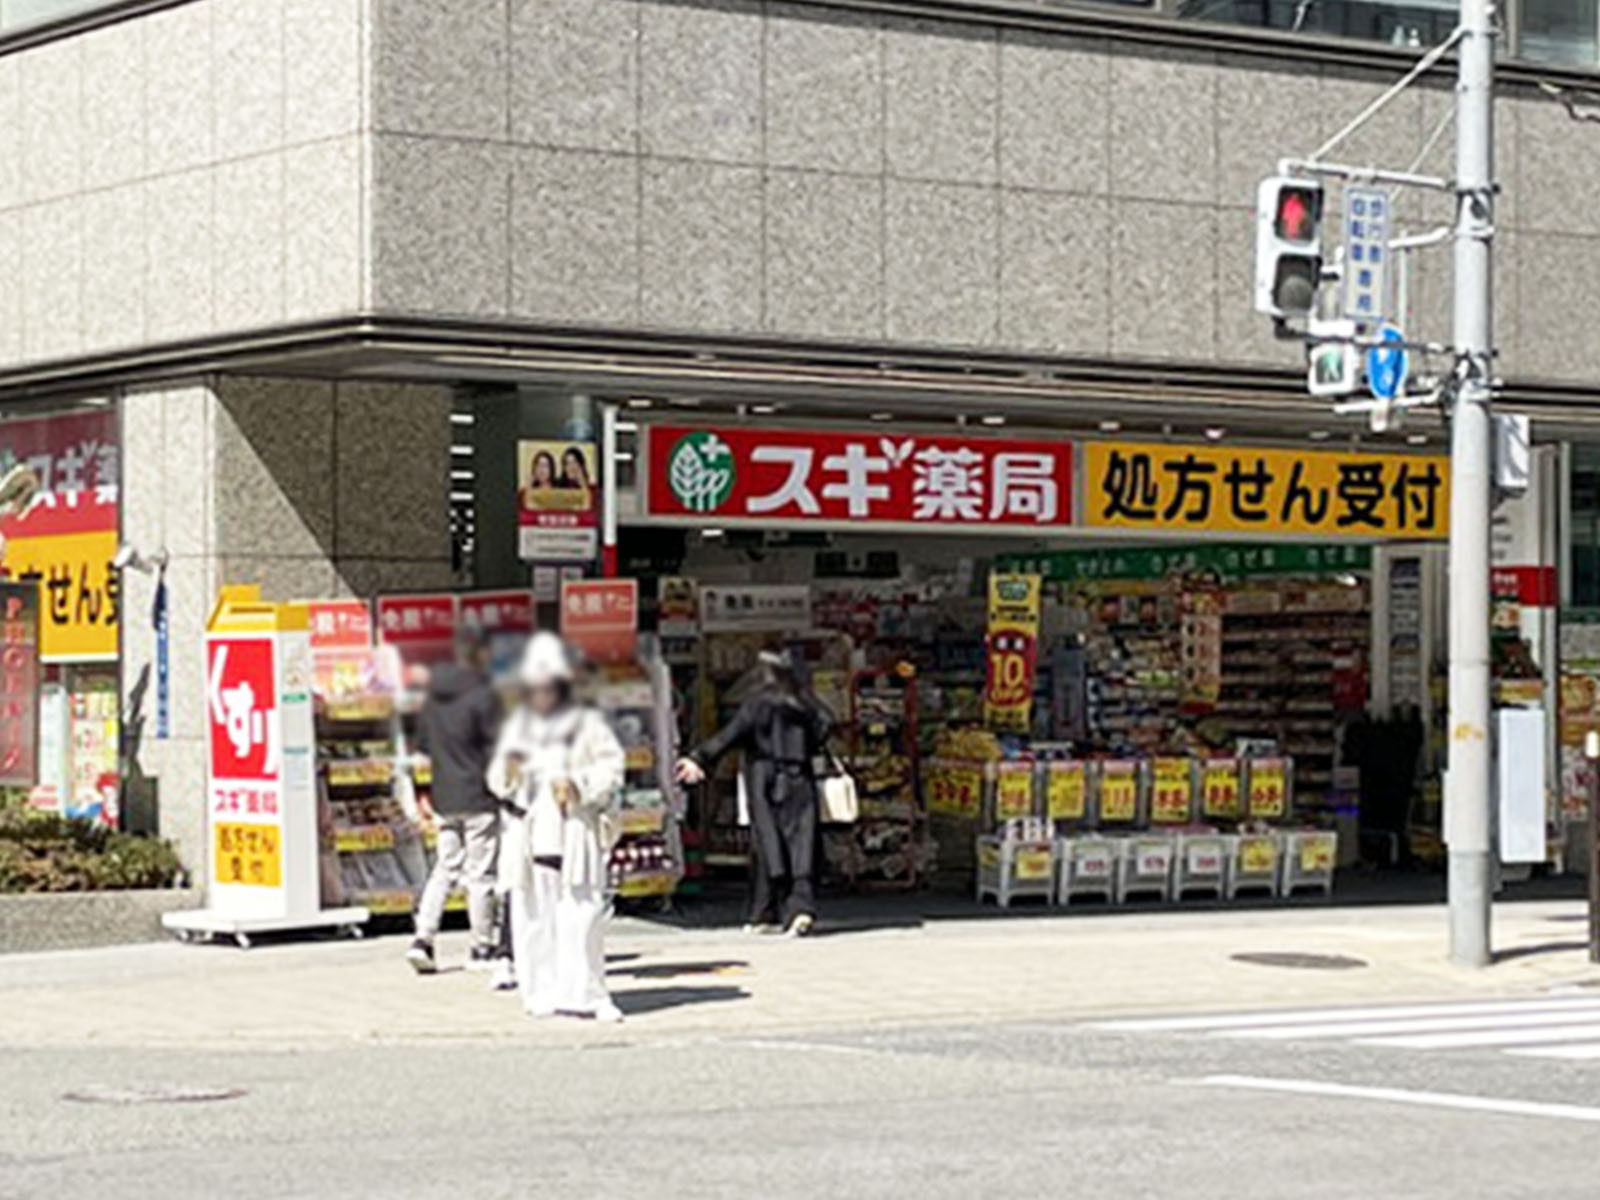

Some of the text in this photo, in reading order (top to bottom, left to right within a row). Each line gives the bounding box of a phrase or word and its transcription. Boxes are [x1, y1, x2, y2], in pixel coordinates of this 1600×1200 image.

[746, 439, 1058, 522] スギ薬局
[1102, 450, 1442, 530] 処方せん受付
[19, 562, 118, 626] せん
